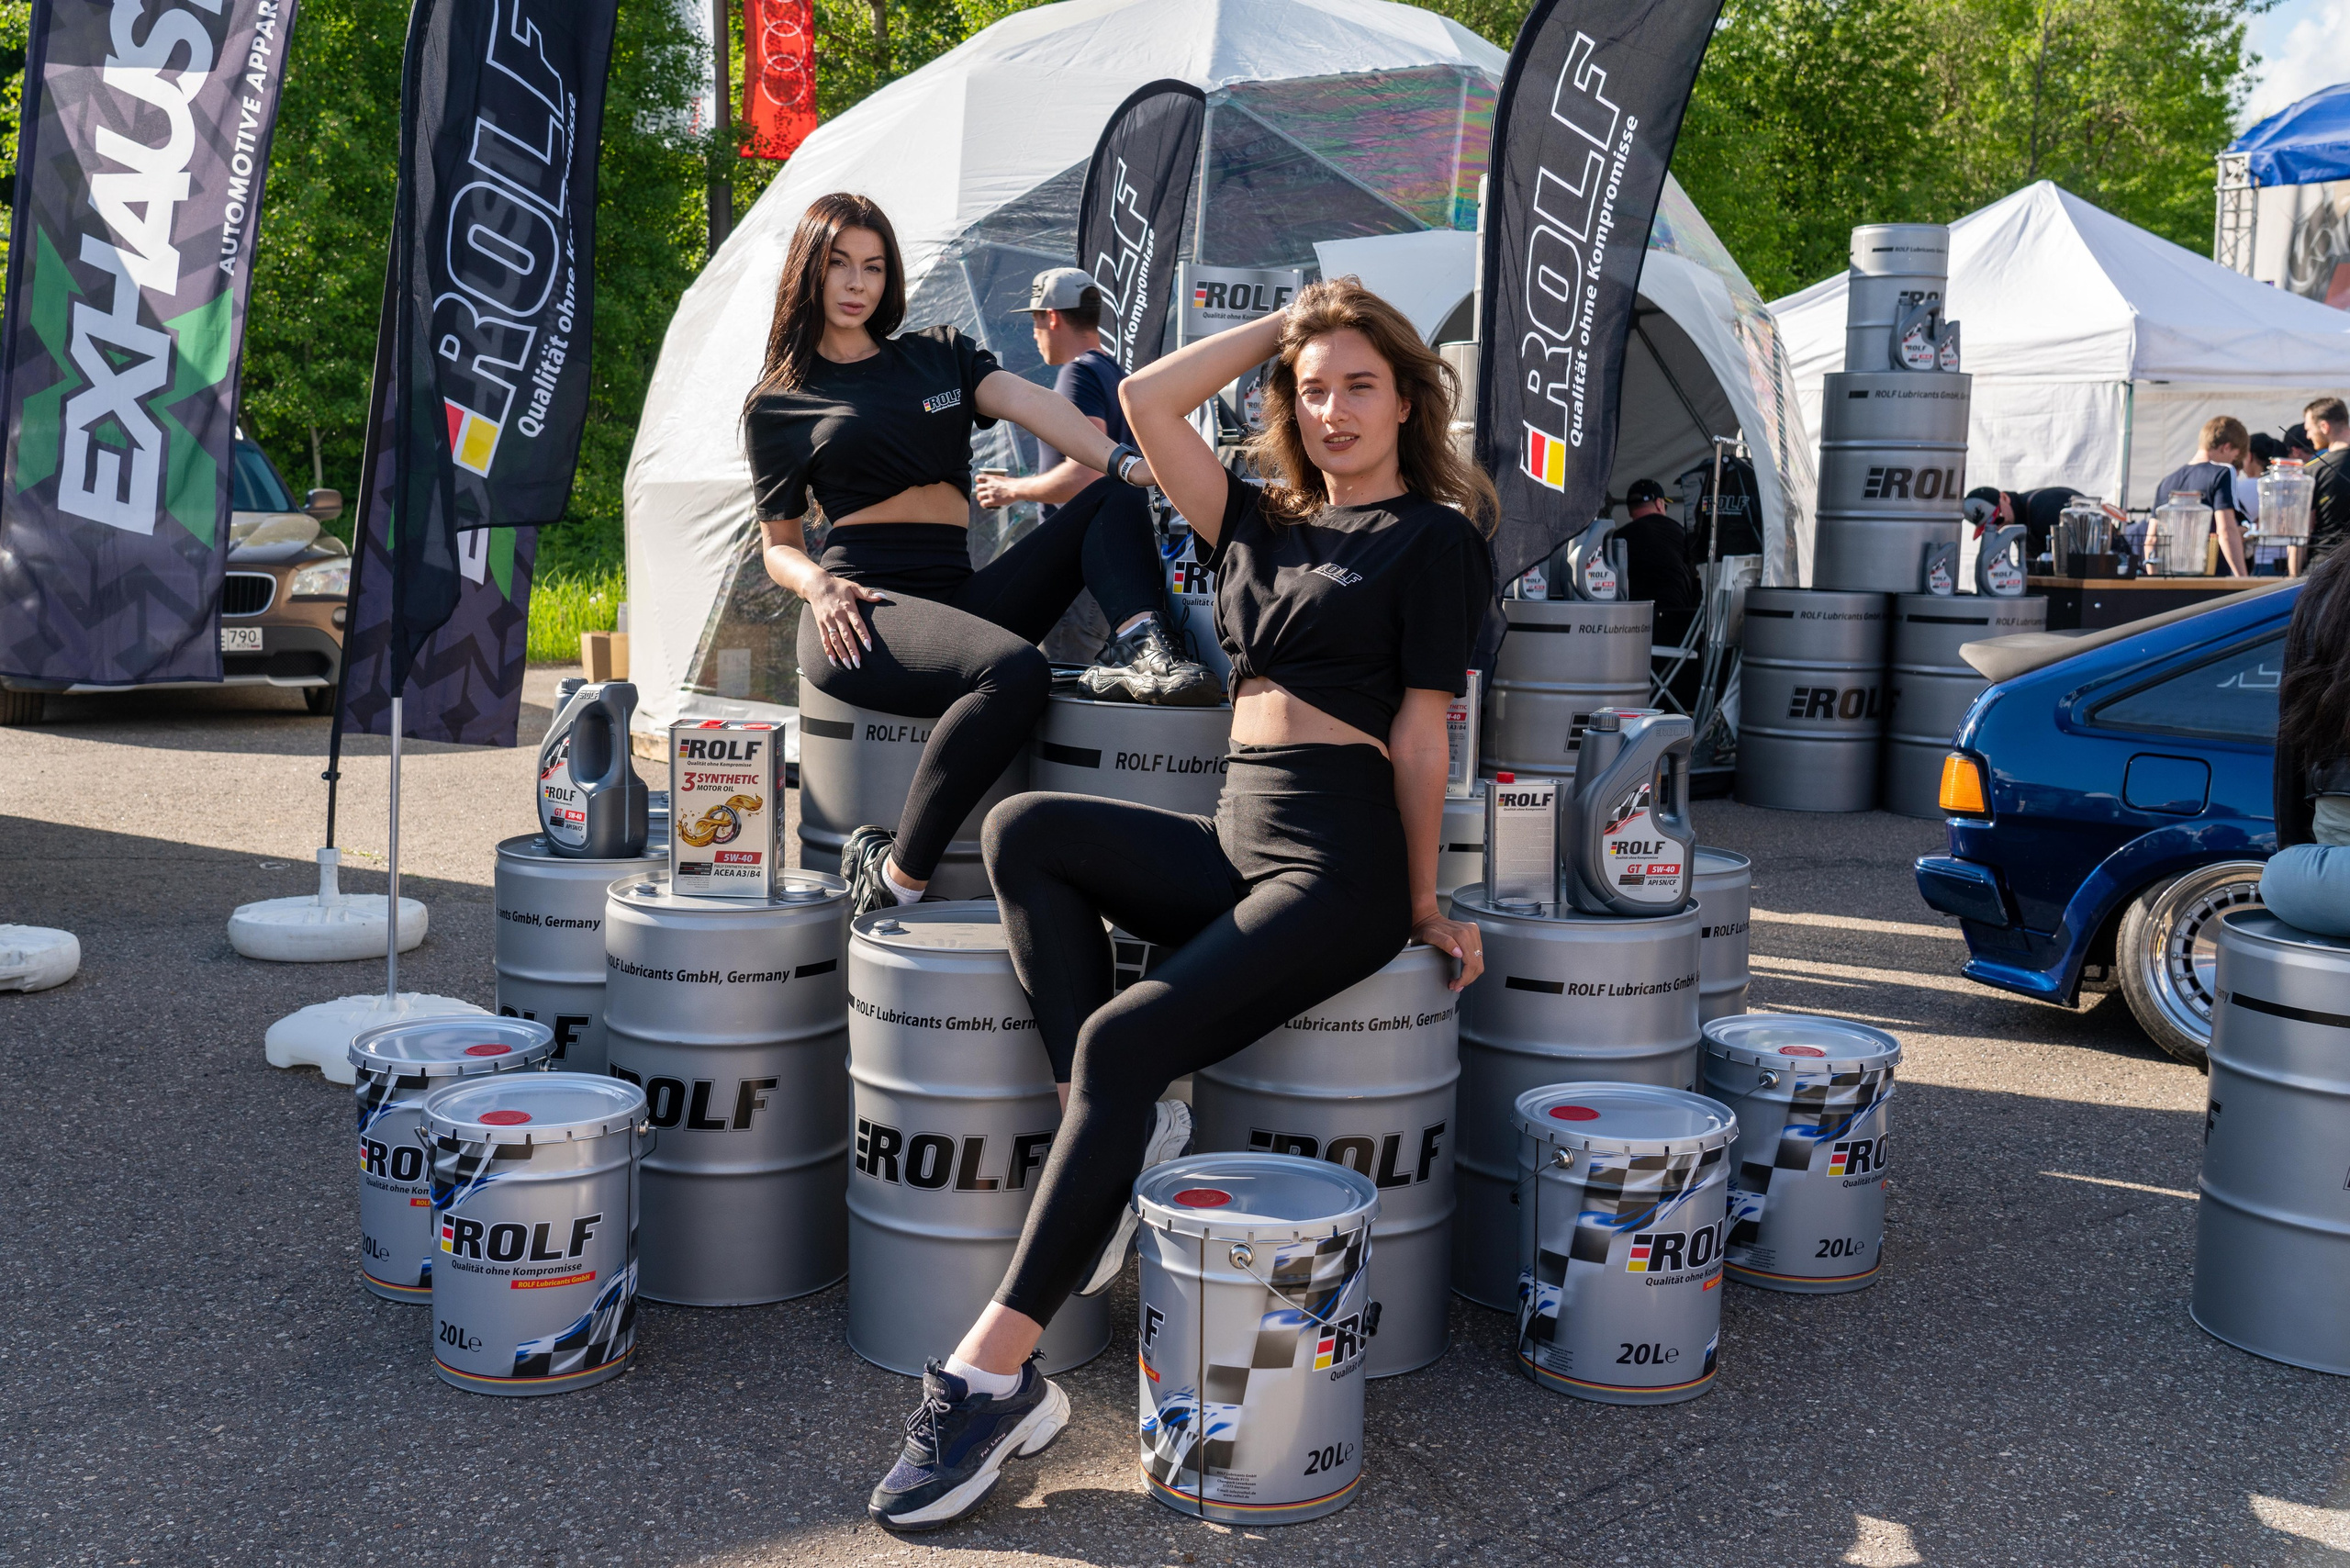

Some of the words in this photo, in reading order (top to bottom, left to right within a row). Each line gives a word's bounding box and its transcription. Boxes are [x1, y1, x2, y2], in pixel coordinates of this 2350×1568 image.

[219, 95, 262, 276] AUTOMOTIVE
[1586, 115, 1639, 281] Kompromisse
[434, 0, 564, 425] ROLF
[1521, 30, 1620, 441] ROLF
[58, 0, 222, 535] EXHAUS
[1124, 228, 1156, 346] Kompromisse
[1204, 280, 1293, 313] ROLF
[1203, 311, 1226, 319] Qualität
[1226, 312, 1242, 320] ohne
[1580, 284, 1598, 346] ohne
[517, 334, 570, 438] Qualität
[556, 266, 576, 333] ohne
[928, 388, 961, 409] ROLF
[1570, 349, 1588, 448] Qualität
[1874, 389, 1897, 398] ROLF
[1897, 390, 1939, 399] Lubricants
[1879, 465, 1965, 501] ROL
[1182, 598, 1210, 607] Qualität
[1800, 610, 1822, 620] ROLF
[1822, 611, 1863, 621] Lubricants
[229, 631, 256, 644] 790
[1579, 624, 1603, 633] ROLF
[1604, 624, 1640, 633] Lubricants
[865, 724, 908, 743] ROLF
[688, 738, 763, 761] ROLF
[1115, 751, 1164, 772] ROLF
[680, 771, 697, 792] 3
[697, 773, 759, 785] SYNTHETIC
[697, 784, 722, 792] MOTOR
[548, 786, 576, 802] ROLF
[1504, 792, 1554, 807] ROLF
[554, 808, 564, 817] GT
[723, 853, 754, 863] 5W-40
[1616, 841, 1666, 855] ROLF
[713, 868, 734, 877] ACEA
[735, 869, 761, 879] A3/B4
[1627, 864, 1642, 874] GT
[512, 911, 542, 927] GmbH,
[544, 915, 601, 932] Germany
[1713, 924, 1735, 937] ROLF
[621, 959, 674, 981] Lubricants
[676, 969, 723, 986] GmbH,
[727, 969, 790, 984] Germany
[1567, 982, 1606, 997] ROLF
[1607, 980, 1672, 997] Lubricants
[1673, 974, 1696, 991] GmbH,
[856, 998, 875, 1017] ROLF
[877, 1006, 942, 1029] Lubricants
[946, 1016, 998, 1033] GmbH,
[1368, 1014, 1414, 1031] GmbH,
[1416, 1007, 1454, 1027] Germany
[617, 1062, 780, 1133] OLF
[366, 1137, 430, 1184] RO
[867, 1119, 1055, 1193] ROLF
[365, 1176, 388, 1192] Qualität
[389, 1183, 410, 1194] ohne
[1842, 1176, 1871, 1189] Qualität
[452, 1211, 604, 1263] ROLF
[451, 1259, 484, 1274] Qualität
[485, 1266, 510, 1276] ohne
[512, 1261, 583, 1278] Kompromisse
[1645, 1275, 1684, 1287] Qualität
[1684, 1271, 1704, 1282] ohne
[536, 1277, 571, 1287] Lubricants
[571, 1273, 590, 1283] GmbH
[1139, 1301, 1166, 1350] F
[1329, 1361, 1358, 1382] Qualität
